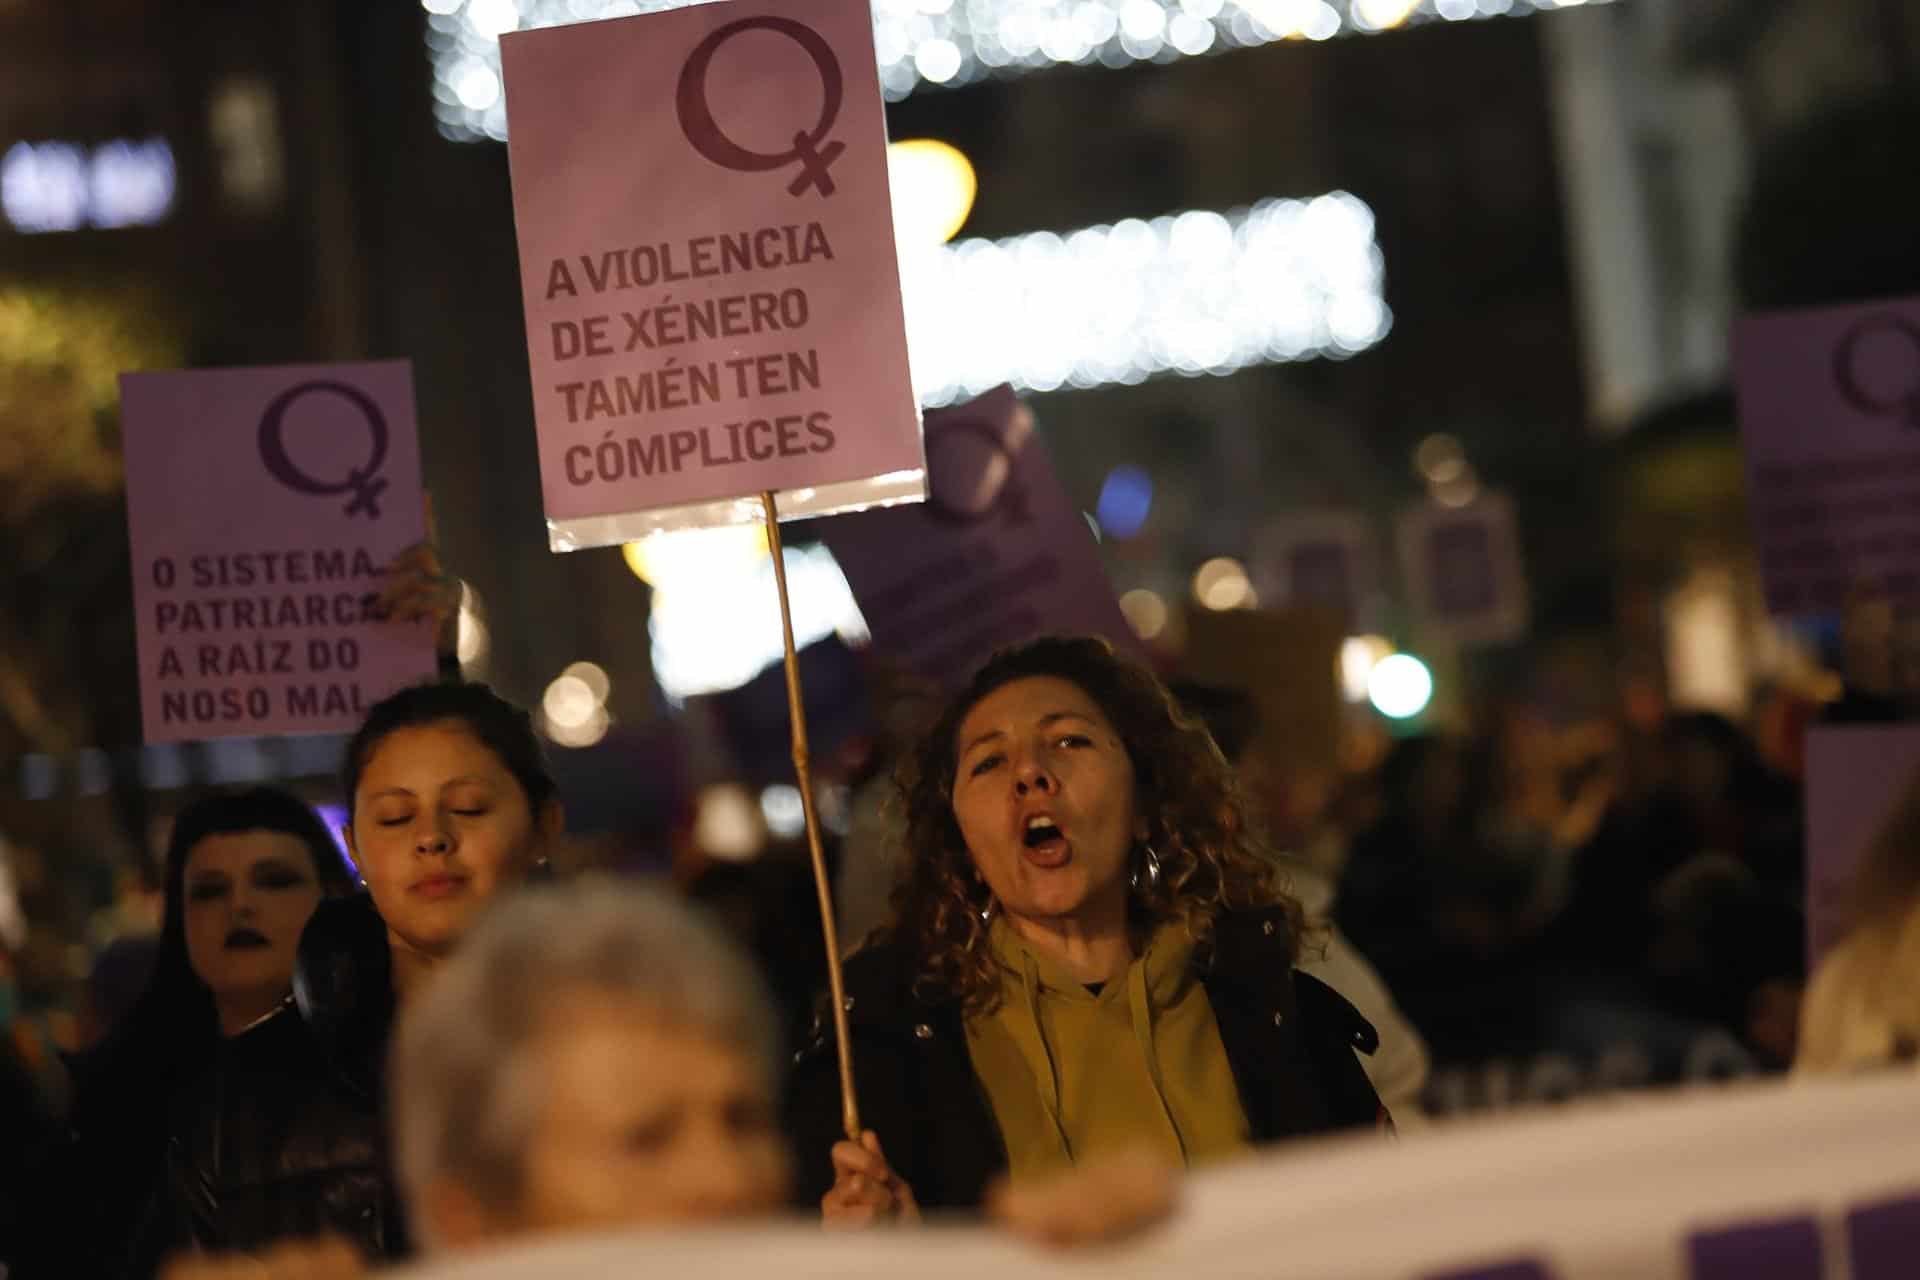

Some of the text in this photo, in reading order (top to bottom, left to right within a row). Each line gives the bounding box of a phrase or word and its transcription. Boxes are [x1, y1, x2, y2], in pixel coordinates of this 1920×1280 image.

[545, 221, 834, 300] A VIOLENCIA
[551, 288, 809, 362] DE XÉNERO
[555, 349, 820, 424] TAMÉN TEN
[564, 411, 836, 486] CÓMPLICES
[152, 548, 375, 589] O SISTEMA
[157, 634, 360, 680] A RAÍZ DO
[161, 682, 369, 723] NOSO MAL
